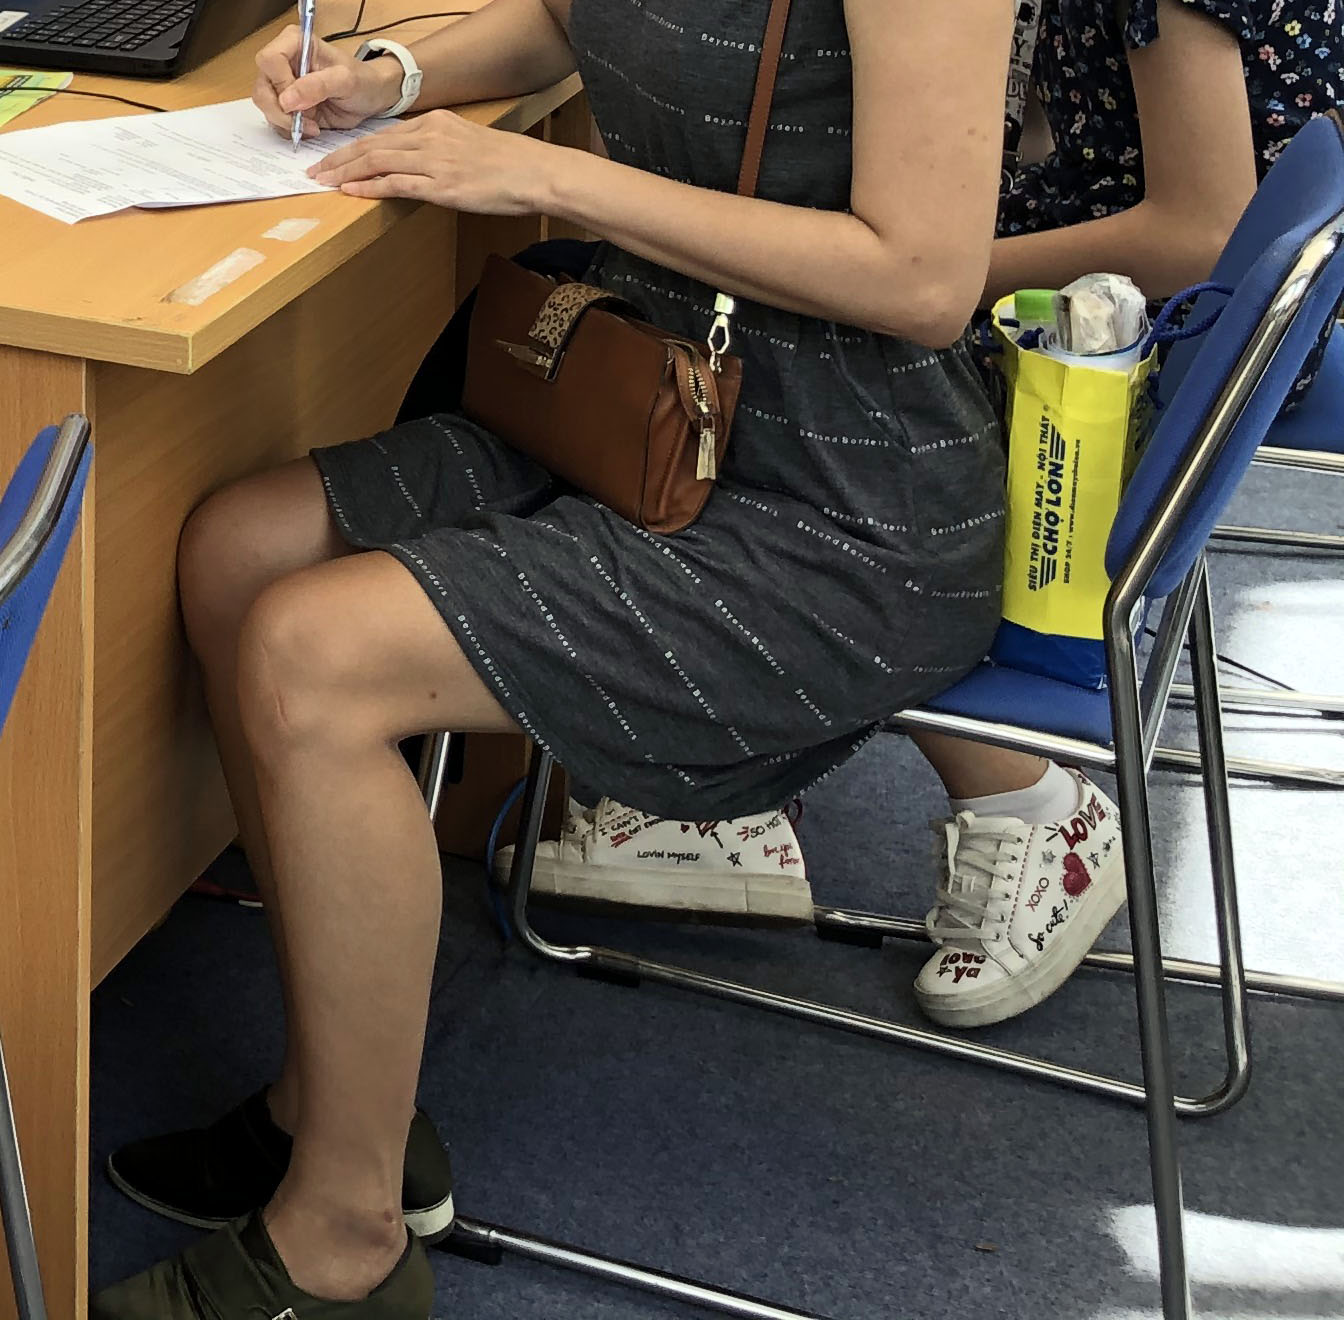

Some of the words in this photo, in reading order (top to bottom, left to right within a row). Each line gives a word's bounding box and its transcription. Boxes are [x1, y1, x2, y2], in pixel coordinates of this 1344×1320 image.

[1043, 508, 1064, 556] CHỢ
[750, 826, 765, 838] SO
[1059, 793, 1107, 850] LOVE
[1025, 877, 1050, 912] XOXO
